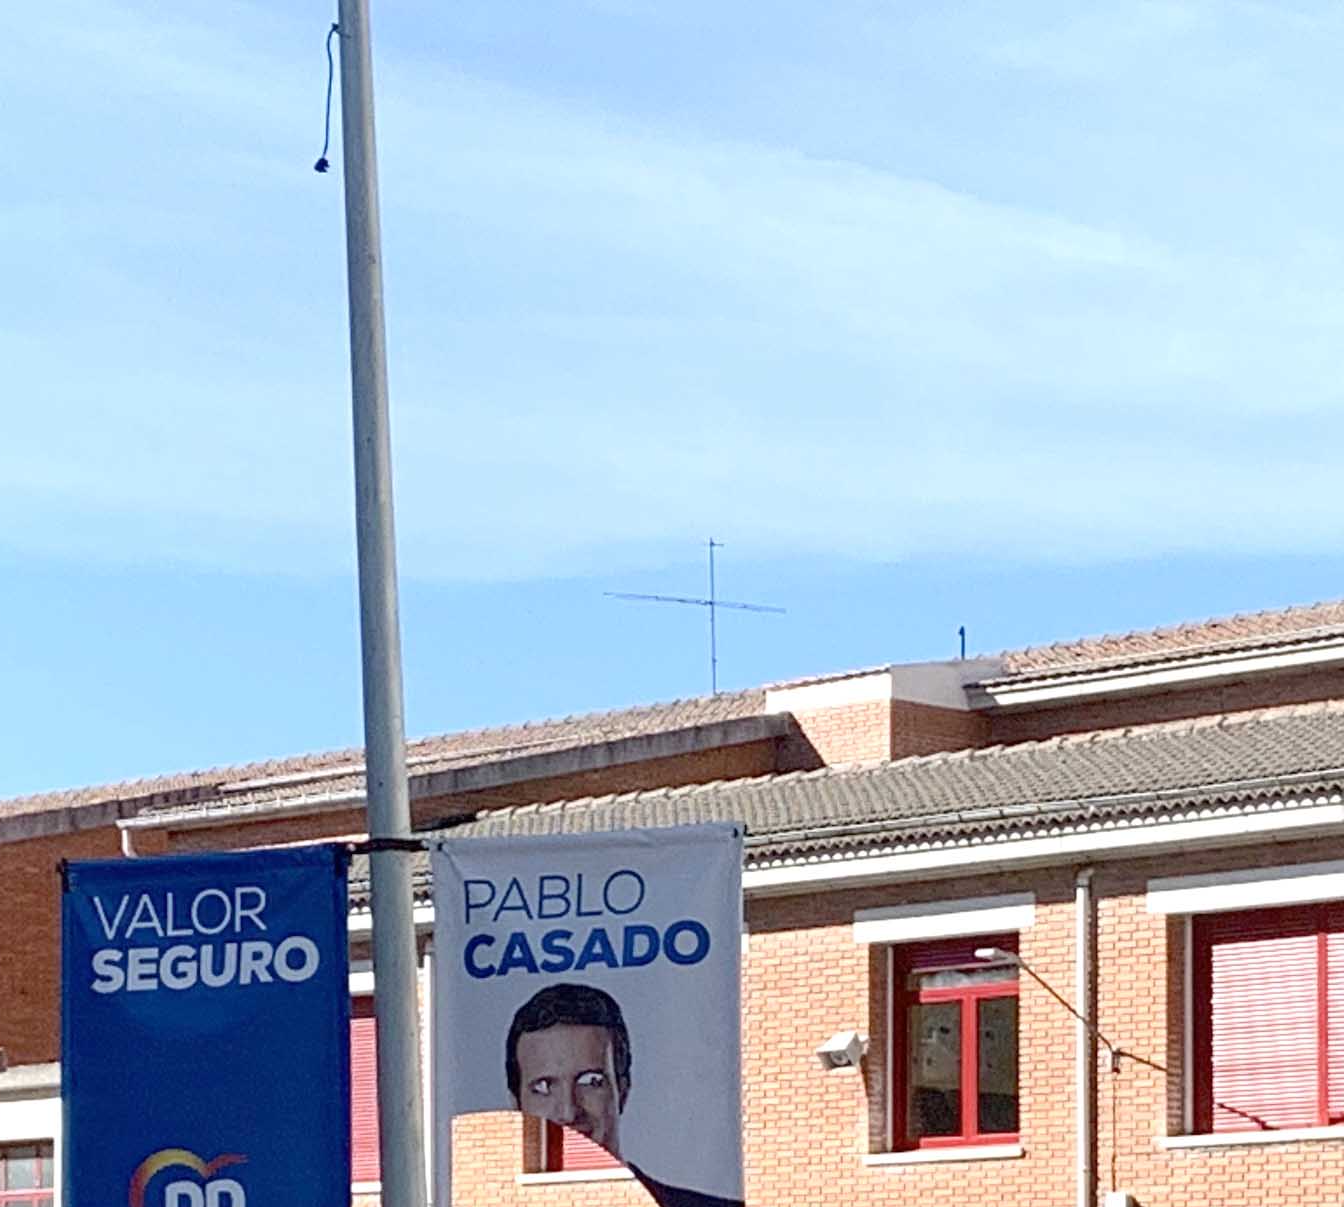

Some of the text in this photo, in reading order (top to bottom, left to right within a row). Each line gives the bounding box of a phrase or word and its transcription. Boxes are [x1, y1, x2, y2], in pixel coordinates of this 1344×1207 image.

[93, 886, 266, 939] VALOR
[465, 870, 645, 924] PABLO
[91, 935, 320, 993] SEGURO
[464, 920, 711, 979] CASADO
